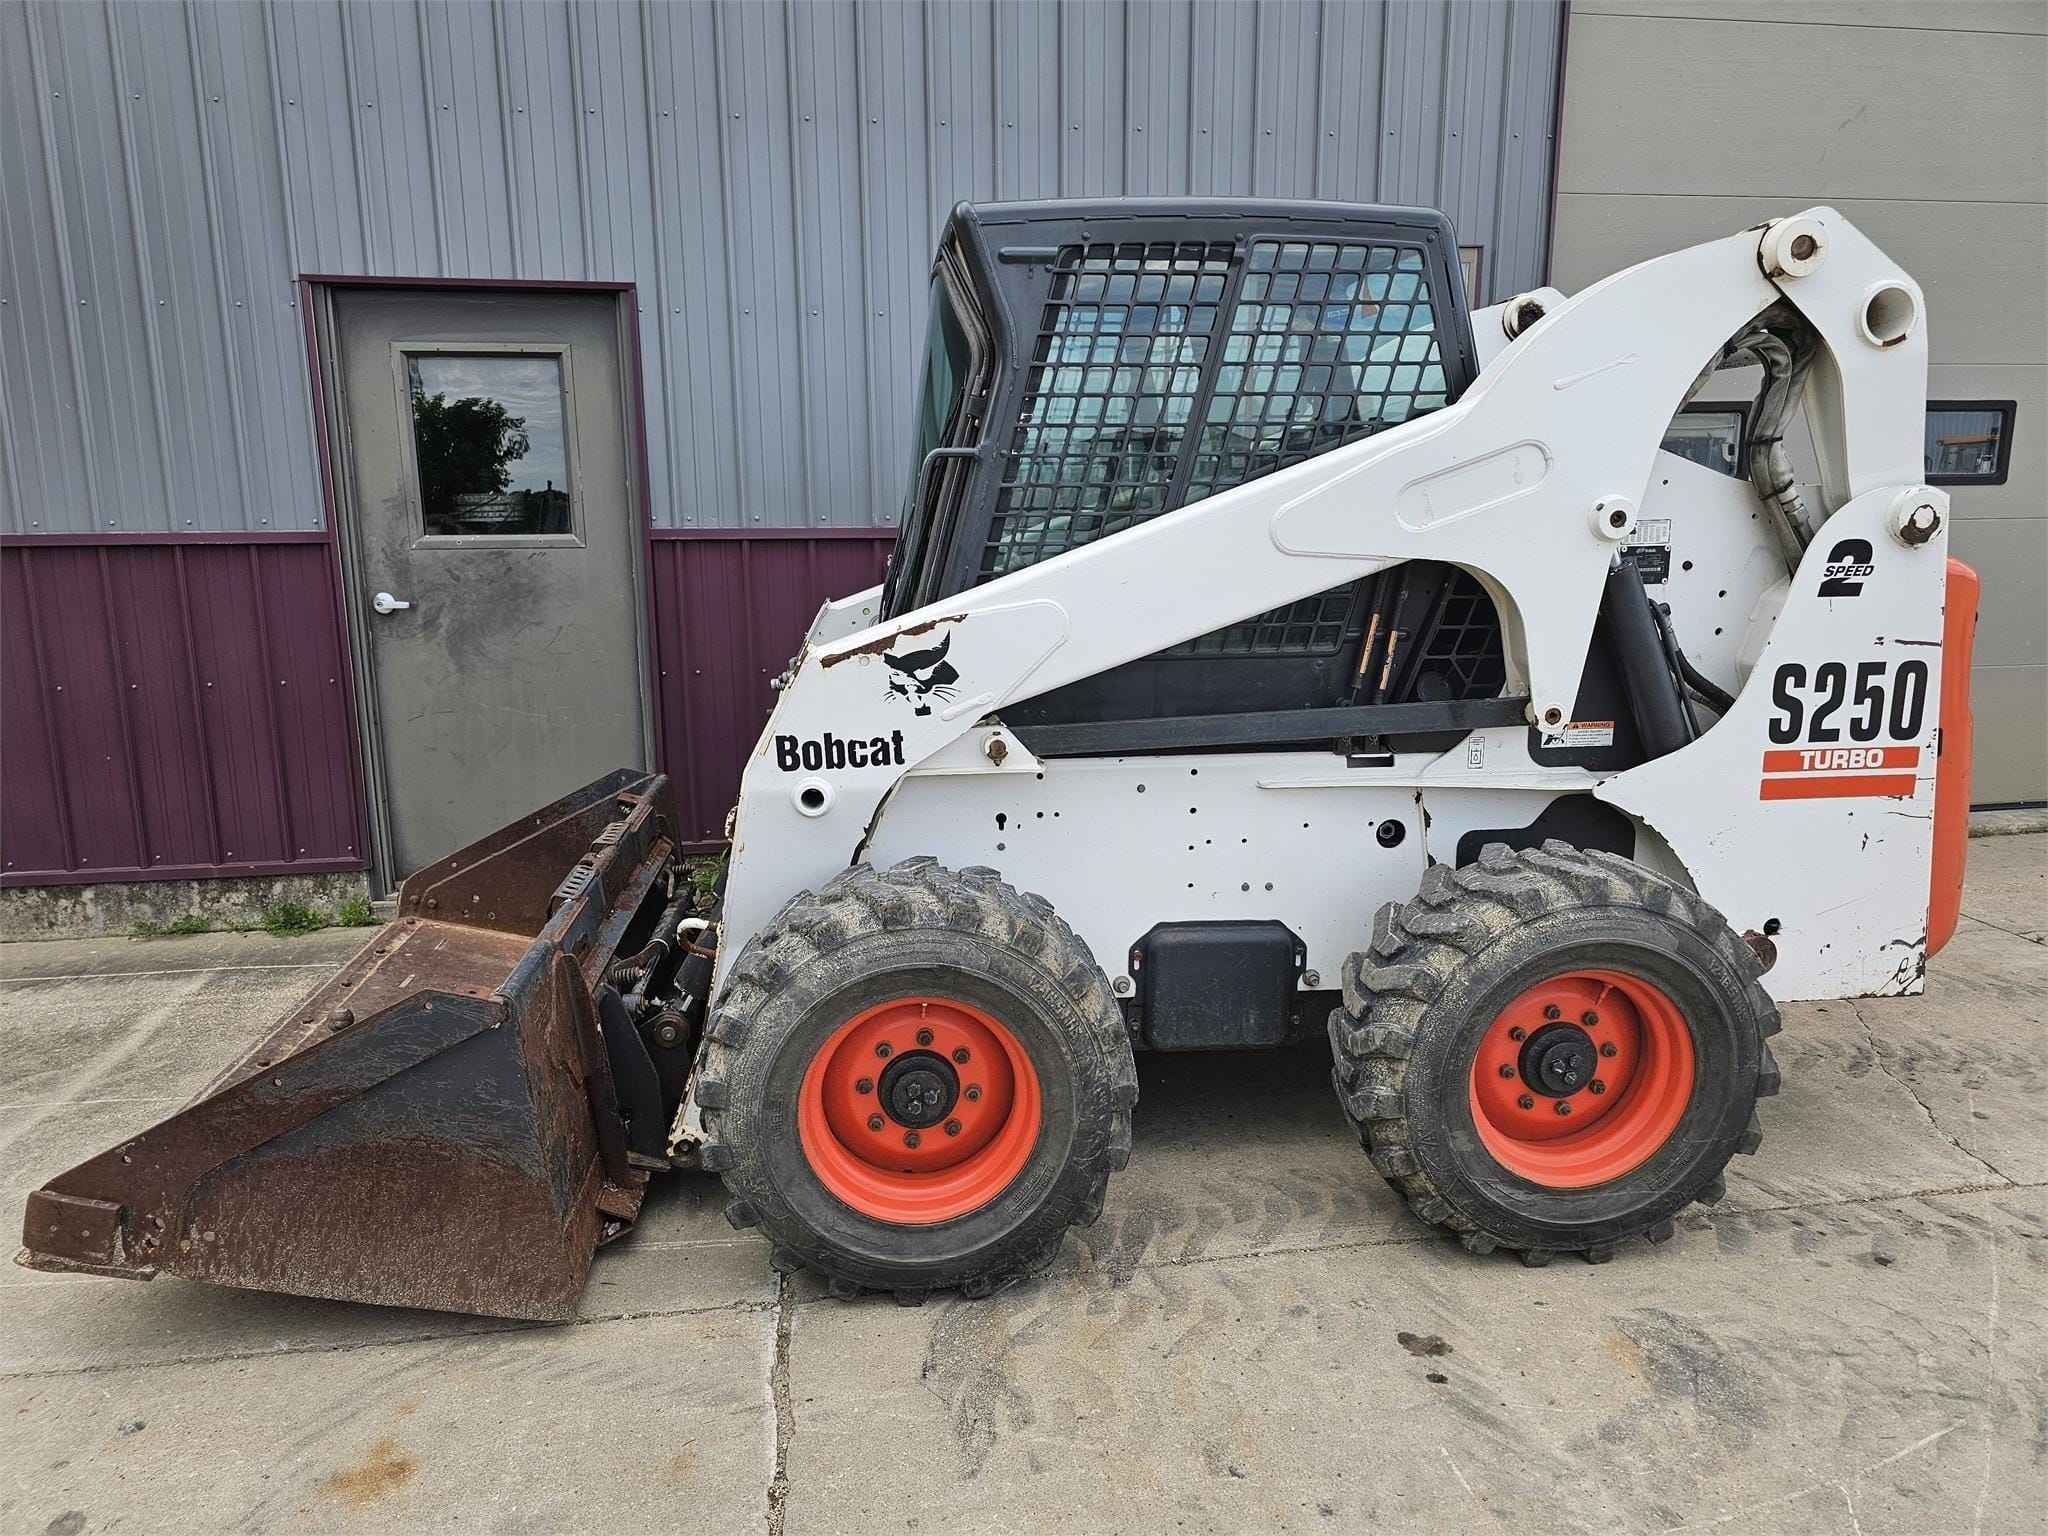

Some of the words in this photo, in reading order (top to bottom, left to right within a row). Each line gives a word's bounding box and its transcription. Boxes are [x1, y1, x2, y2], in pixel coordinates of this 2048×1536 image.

[1817, 538, 1873, 597] 2
[1824, 564, 1875, 578] SPEED
[1768, 660, 1929, 744] S250
[775, 730, 906, 772] Bobcat
[1800, 749, 1884, 770] TURBO
